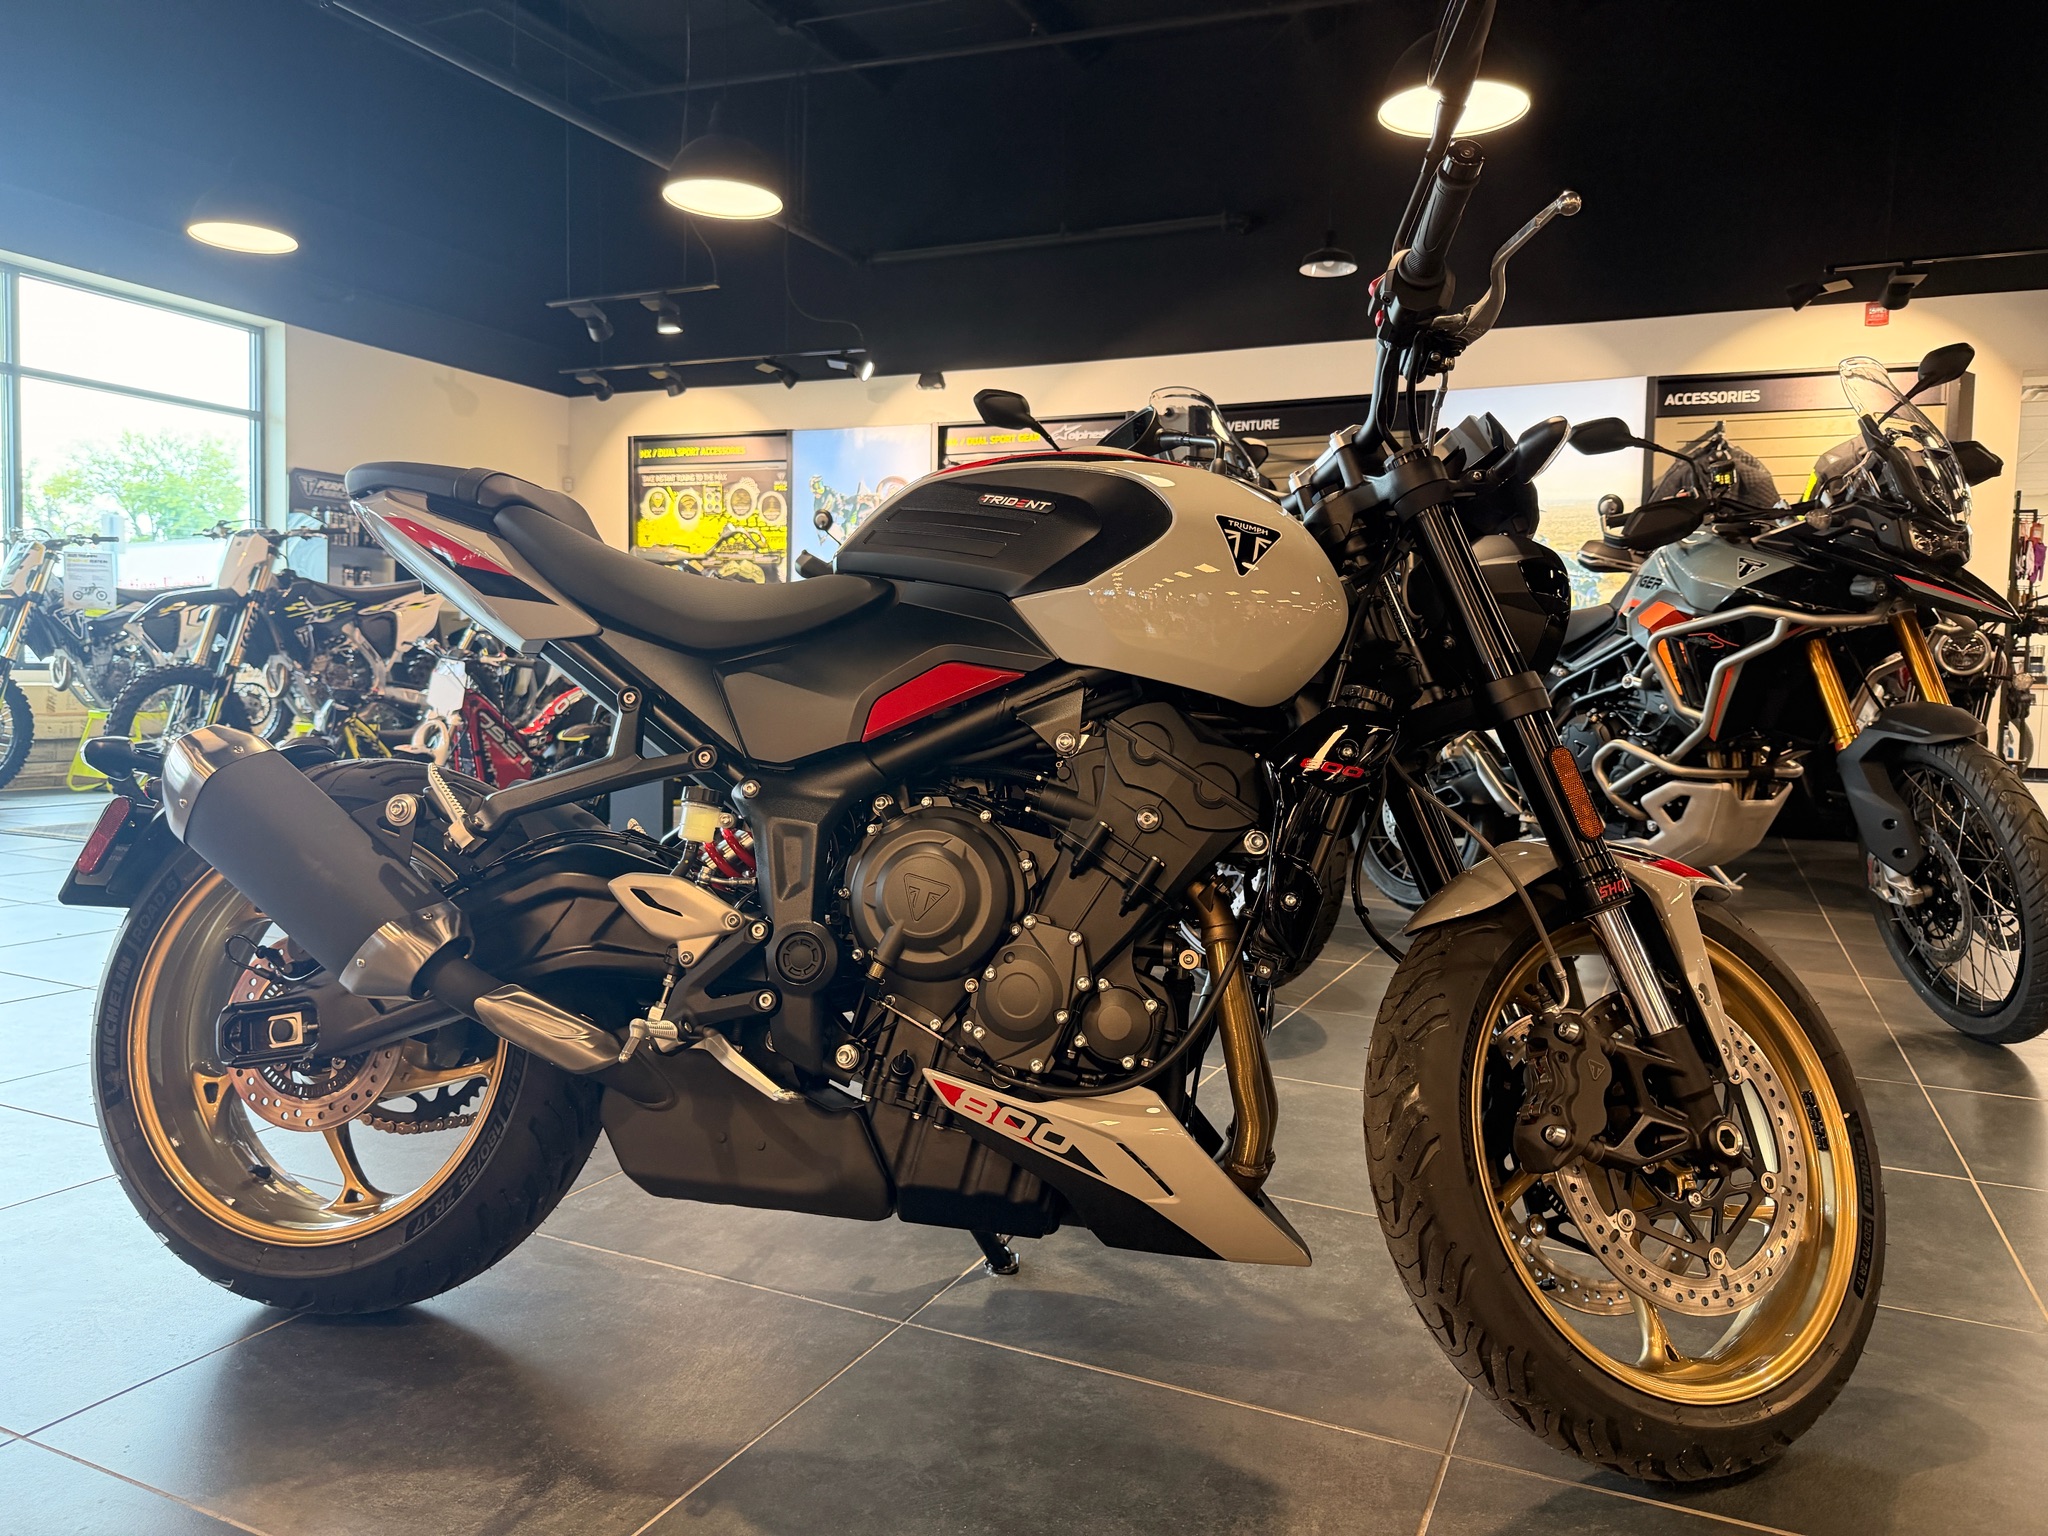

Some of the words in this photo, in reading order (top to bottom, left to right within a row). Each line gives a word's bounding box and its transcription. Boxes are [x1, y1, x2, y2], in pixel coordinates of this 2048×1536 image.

[1664, 390, 1760, 406] ACCESSORIES
[1226, 418, 1280, 432] VENTURE
[990, 434, 1016, 445] SPORT
[1017, 432, 1041, 442] GEAR
[676, 447, 699, 457] SPORT
[701, 446, 746, 456] ACCESSORIES
[982, 494, 1052, 511] TRIDENT
[1228, 519, 1269, 536] TRIUMPH
[480, 712, 532, 765] OSET
[1300, 757, 1365, 778] 800
[1599, 878, 1631, 899] SHO
[103, 955, 133, 1067] MICHELIN
[132, 892, 168, 942] ROAD
[954, 1089, 1074, 1154] 800
[460, 1124, 506, 1190] 180/55
[1857, 1137, 1873, 1208] MICHELIN
[434, 1189, 456, 1215] ZR
[413, 1213, 431, 1235] 17
[1861, 1220, 1873, 1259] 120/70
[1859, 1259, 1870, 1275] ZR
[1855, 1277, 1865, 1291] 17
